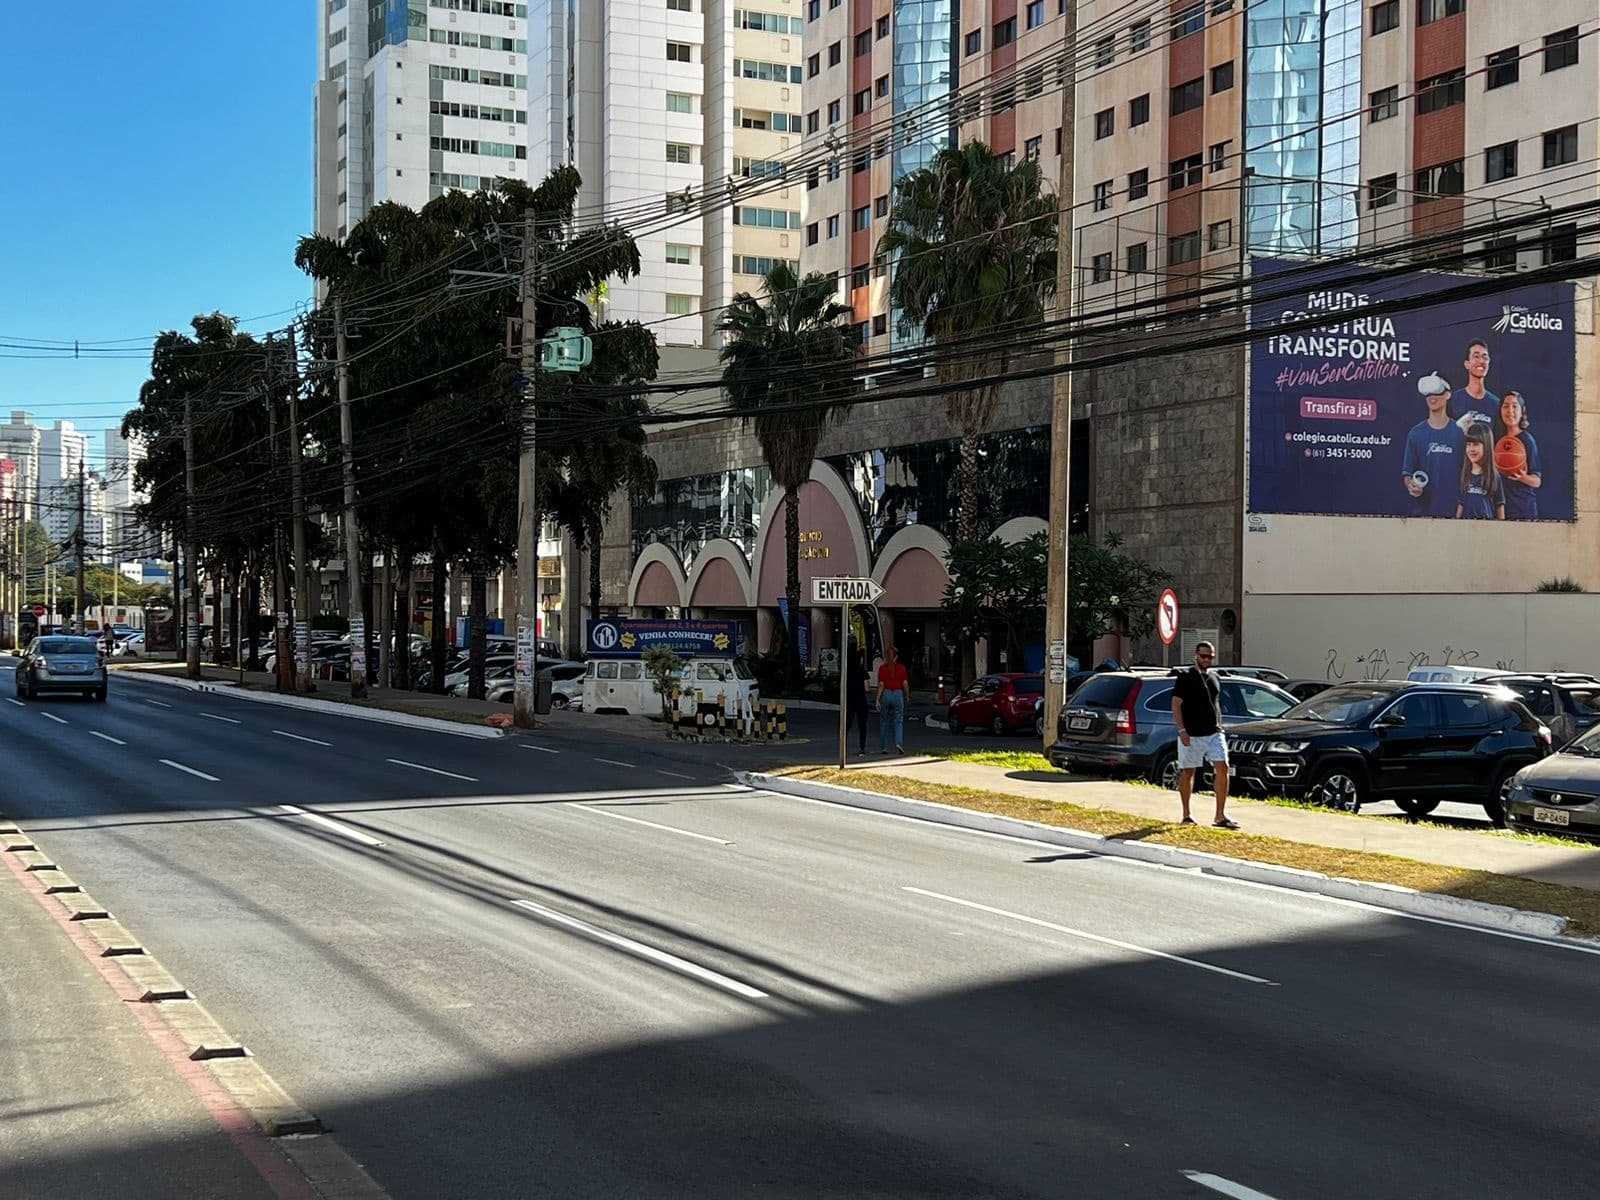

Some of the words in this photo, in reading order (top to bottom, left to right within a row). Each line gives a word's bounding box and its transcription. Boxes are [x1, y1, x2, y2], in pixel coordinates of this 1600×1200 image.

[1308, 291, 1370, 311] MUDE
[1510, 312, 1563, 331] Católica
[1268, 334, 1410, 361] TRANSFORME
[1305, 401, 1356, 415] Transfira
[1357, 402, 1372, 418] já!
[1293, 431, 1391, 445] colegio.catolica.edu.br
[1312, 449, 1325, 458] (61)
[1326, 448, 1372, 459] 3451-5000
[818, 581, 871, 600] ENTRADA
[638, 632, 667, 641] VENHA
[668, 631, 713, 642] CONHECER!
